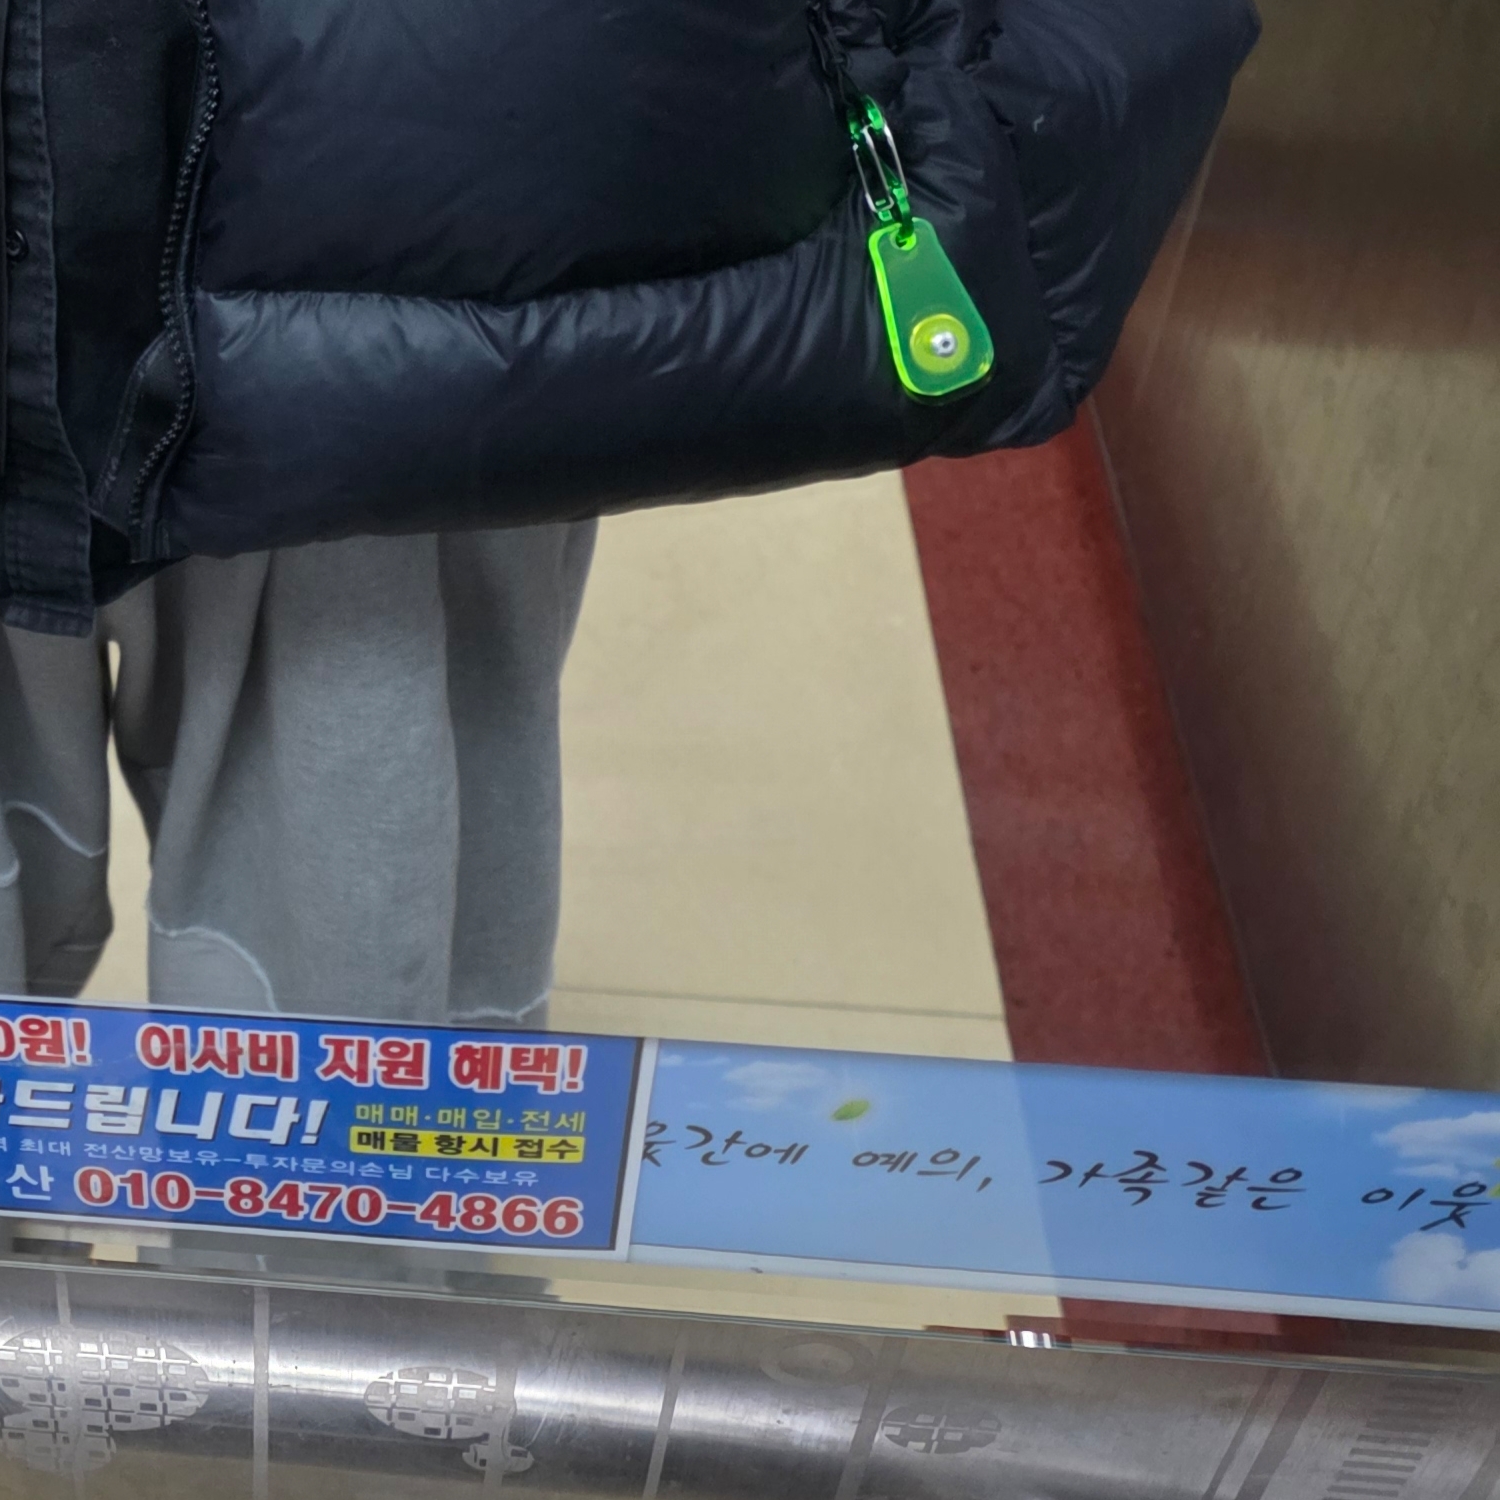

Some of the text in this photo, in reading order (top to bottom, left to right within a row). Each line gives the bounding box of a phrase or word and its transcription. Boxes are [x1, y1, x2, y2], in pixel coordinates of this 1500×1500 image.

[136, 1021, 300, 1081] 이사비
[318, 1031, 430, 1089] 지원
[450, 1040, 588, 1094] 혜택!
[18, 1138, 72, 1157] 최대
[425, 1167, 540, 1187] 다수보유
[356, 1131, 581, 1160] 매물 항시 접수
[71, 1165, 585, 1240] 010-8470-4866
[851, 1146, 994, 1193] 예의,
[1038, 1149, 1307, 1211] 가족같은
[1361, 1181, 1492, 1231] 이웃
